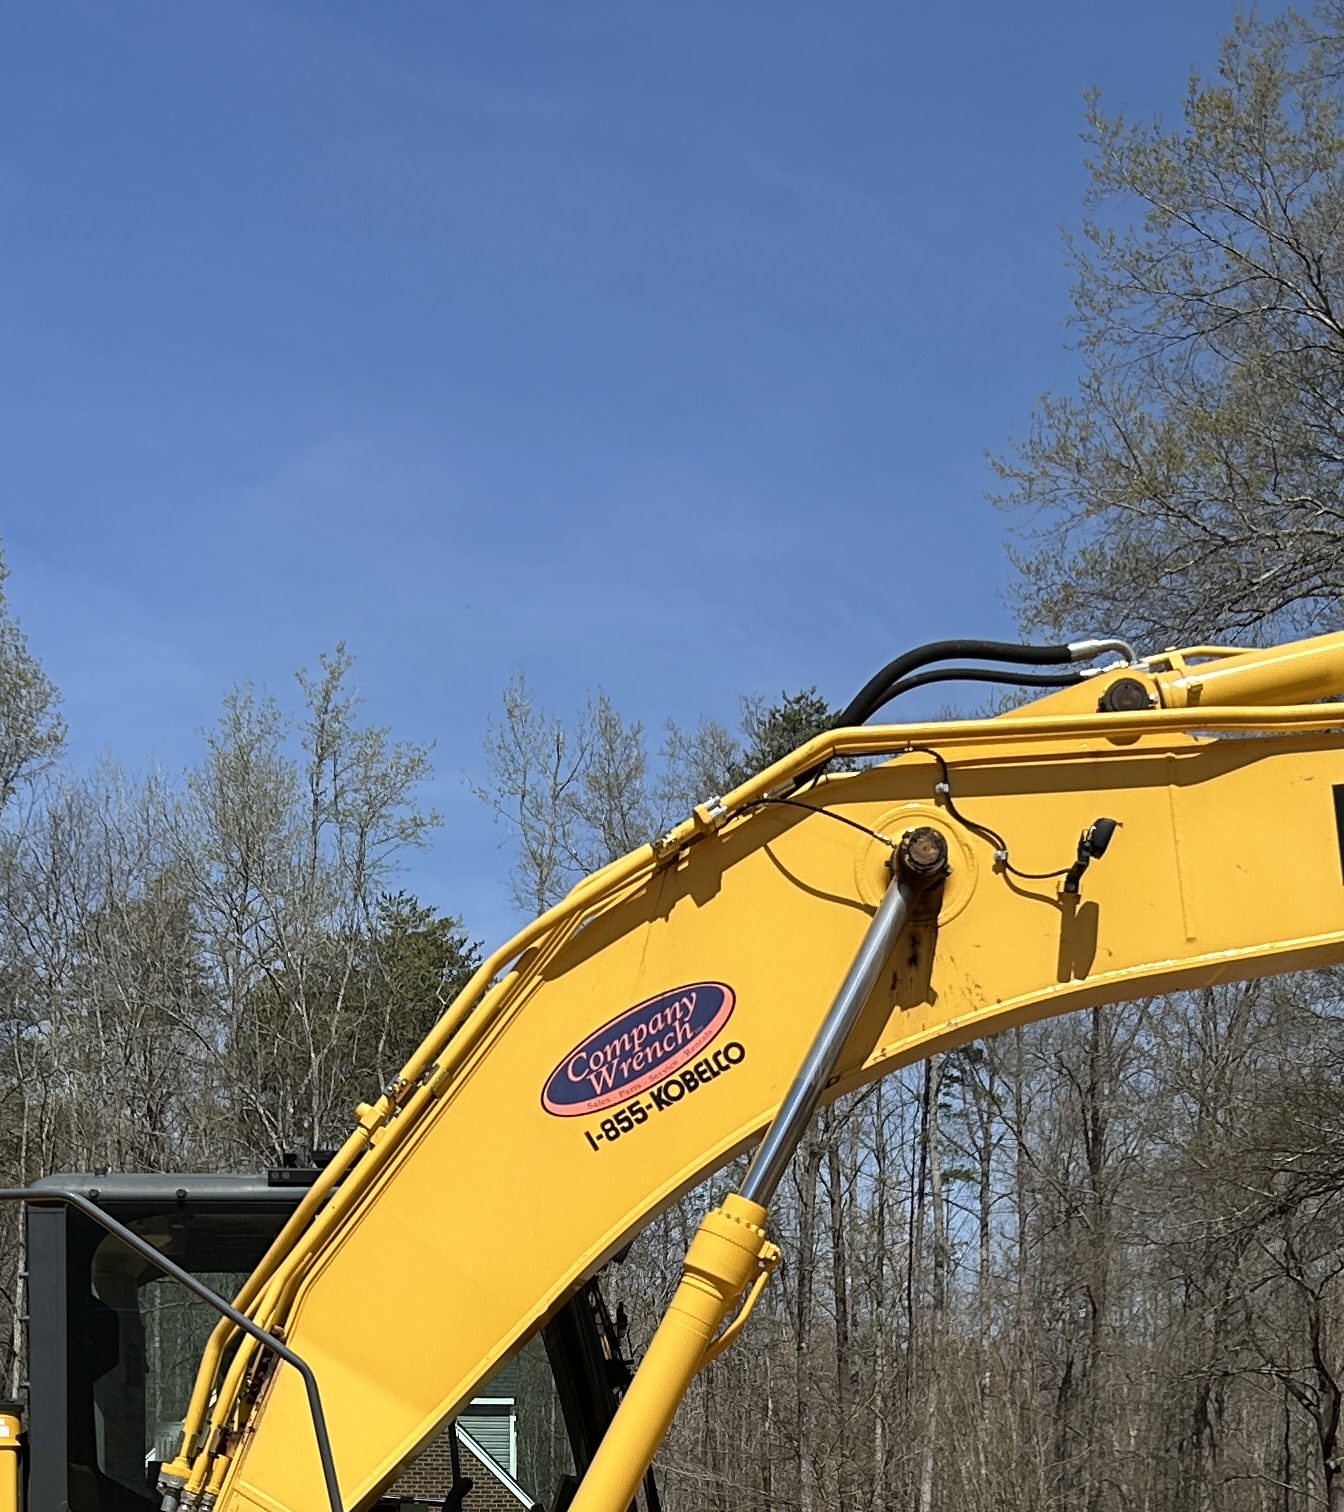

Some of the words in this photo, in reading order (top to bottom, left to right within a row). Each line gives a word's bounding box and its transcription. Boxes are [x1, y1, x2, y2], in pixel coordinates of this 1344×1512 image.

[566, 991, 698, 1083] Company
[586, 1019, 695, 1096] Wrench
[584, 1041, 746, 1152] 1-855-KOBELCO
